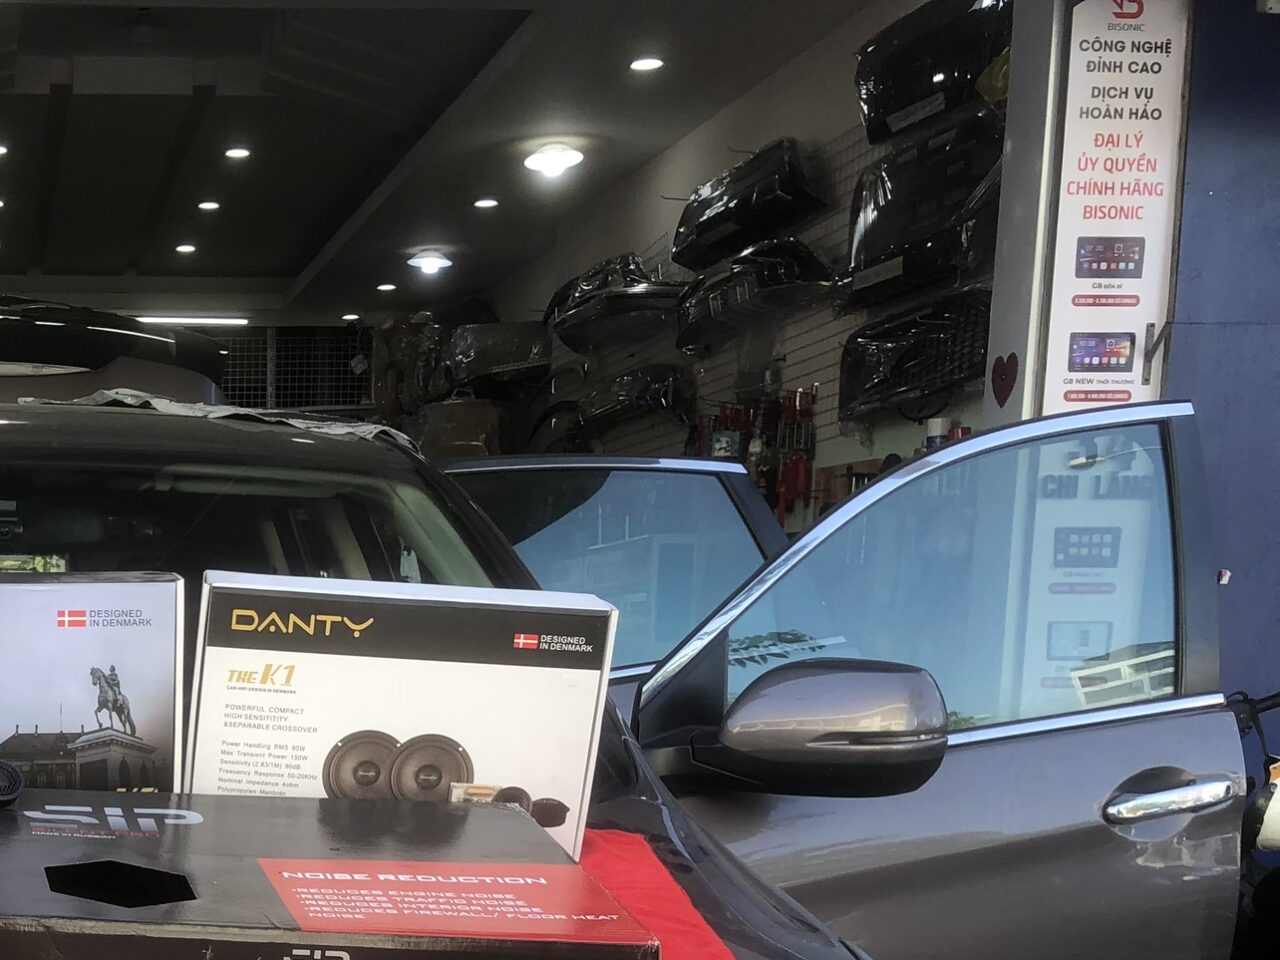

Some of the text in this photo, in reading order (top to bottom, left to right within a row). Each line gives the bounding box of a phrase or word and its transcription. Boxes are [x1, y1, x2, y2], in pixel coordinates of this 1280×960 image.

[1107, 23, 1145, 32] BISONIC
[1079, 37, 1172, 57] CÔNG NGHỆ
[1086, 56, 1162, 74] ĐỈNH CAO
[1091, 86, 1154, 103] DỊCH VỤ
[1079, 104, 1162, 121] HOÀN HẢO
[1094, 131, 1143, 151] ĐẠI LÝ
[1077, 153, 1157, 174] ỦY QUYỀN
[1066, 178, 1164, 197] CHÍNH HÃNG
[1082, 205, 1144, 220] BISONIC
[89, 609, 142, 618] DESIGNED
[89, 618, 152, 627] IN DENMARK
[231, 608, 374, 638] DANTY
[540, 634, 586, 645] DESIGNED
[550, 643, 593, 653] DENMARK
[227, 663, 296, 687] THE K1
[224, 703, 304, 715] POWERFUL COMPACT
[223, 712, 242, 720] HIGH
[271, 724, 318, 734] CROSSOVER
[221, 739, 241, 748] Power
[243, 742, 271, 751] Handling
[273, 743, 289, 751] RMS
[237, 750, 265, 759] Transient
[219, 758, 251, 768] Sensitivity
[253, 770, 285, 779] Response
[217, 776, 243, 784] Nominal
[245, 778, 279, 787] Impedance
[282, 871, 548, 885] NOISE REDUCTION
[388, 890, 457, 898] ENGINE
[392, 896, 468, 904] TRAFFIC
[398, 903, 483, 911] INTERIOR
[308, 911, 367, 919] NOISE
